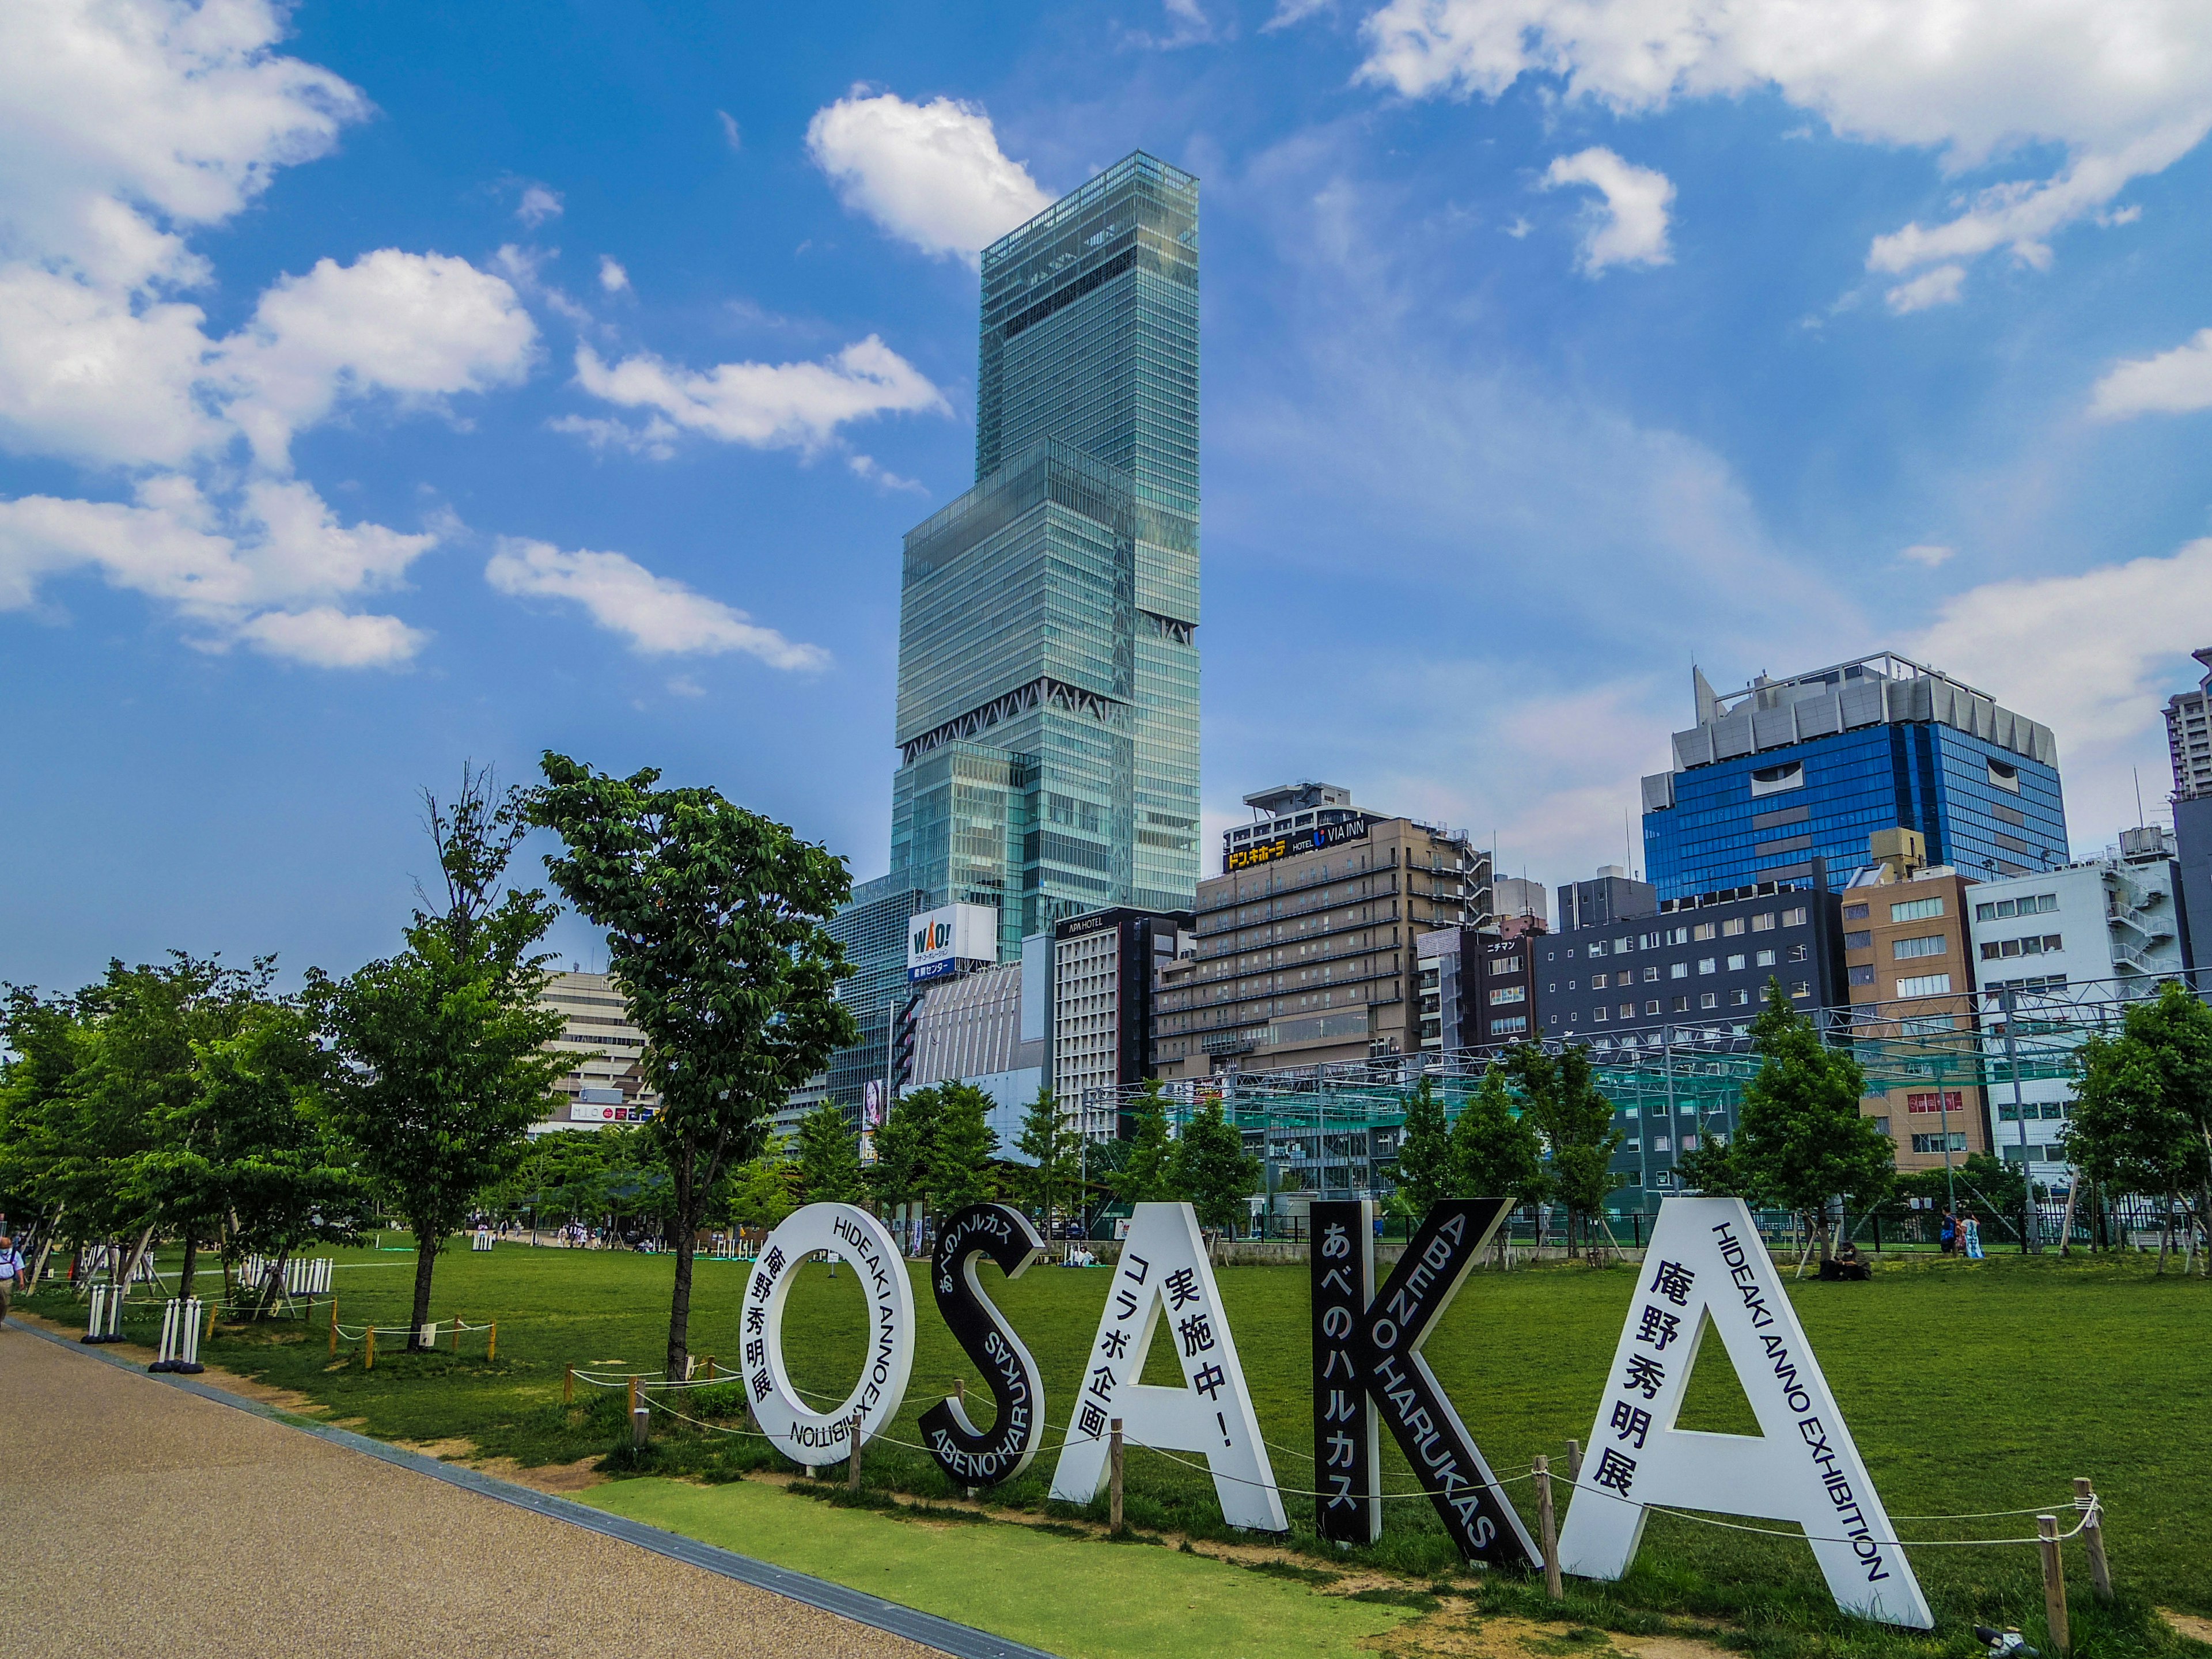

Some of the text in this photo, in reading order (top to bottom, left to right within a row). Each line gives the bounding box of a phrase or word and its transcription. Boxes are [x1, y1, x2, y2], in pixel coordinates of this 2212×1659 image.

[1293, 819, 1364, 852] HOTEL VIA INN
[914, 914, 951, 955] WAO!
[1069, 916, 1103, 933] APA HOTEL
[1487, 941, 1515, 953] ニチマン
[746, 1245, 786, 1404] 庵野秀明展
[833, 1216, 891, 1300] HIDEAKI
[873, 1305, 893, 1384] ANNO
[940, 1213, 1012, 1293] あべのハルカス
[740, 1196, 1934, 1629] OSAKA
[1078, 1253, 1149, 1441] コラボ企画
[1320, 1222, 1358, 1512] あべのハルカス
[1592, 1260, 1695, 1498] 庵野秀明展
[1711, 1221, 1890, 1582] HIDEAKI ANNO EXHIBITION
[1373, 1355, 1496, 1549] HARUKAS
